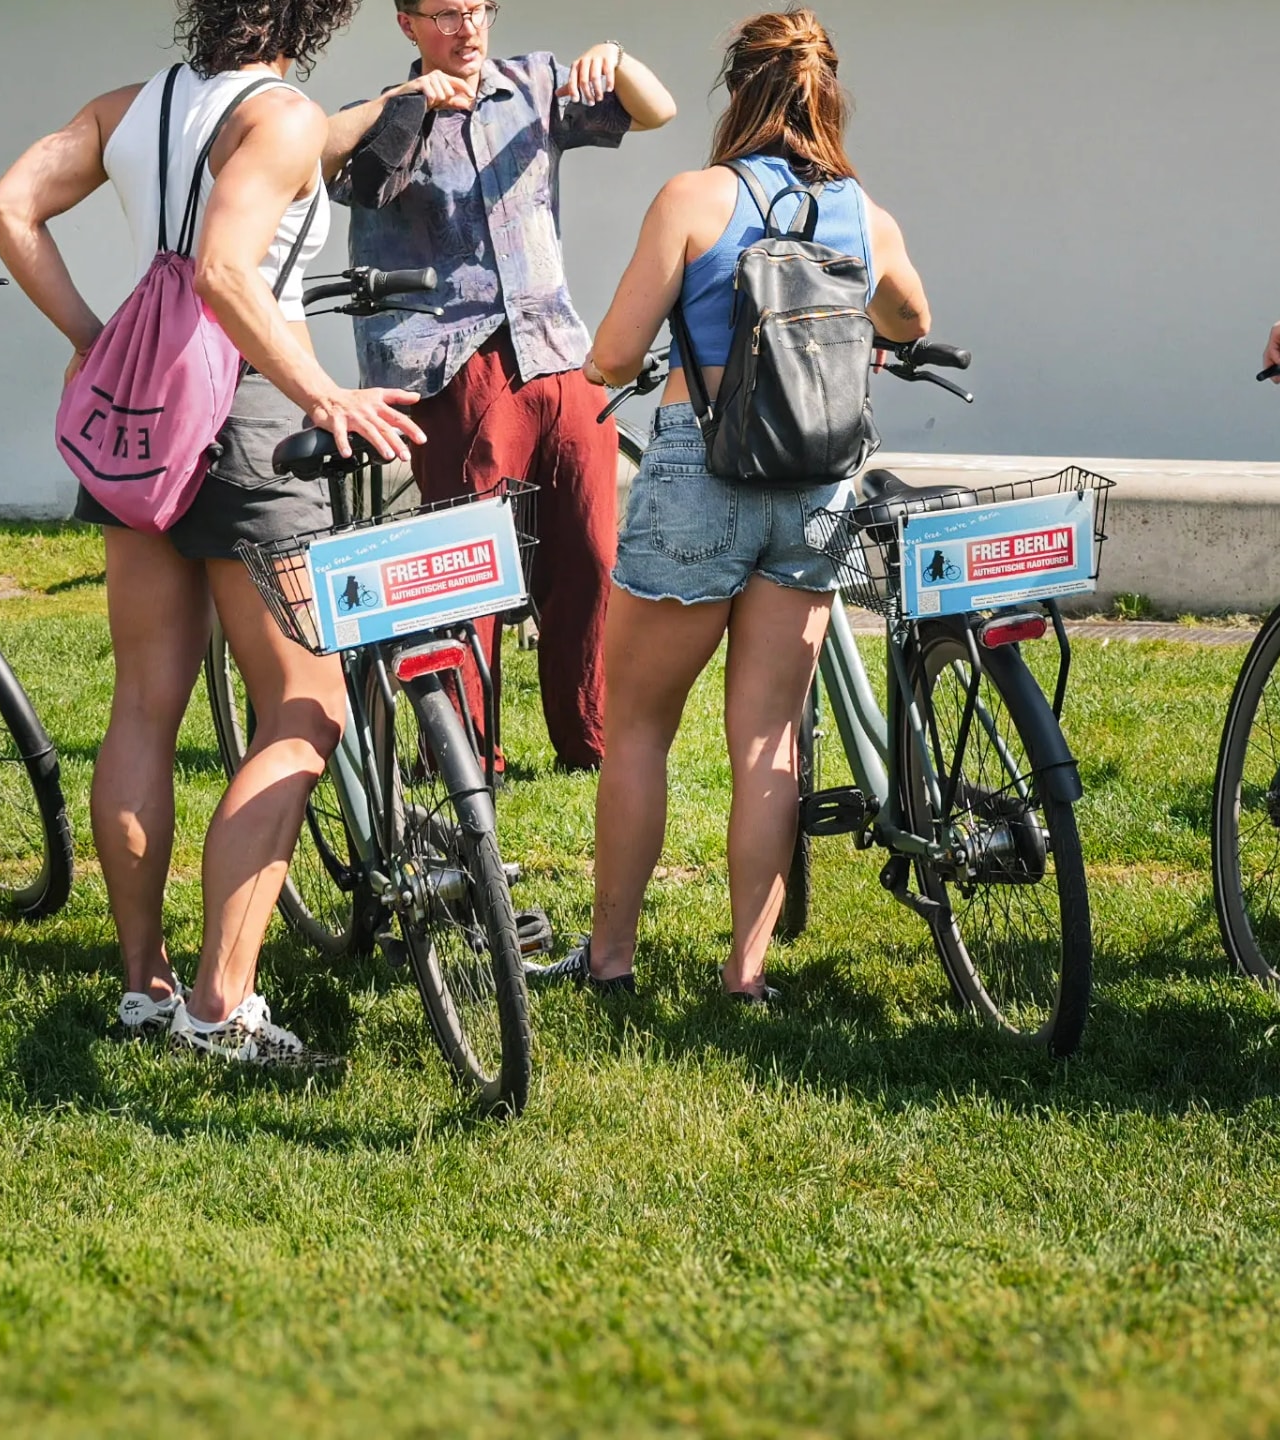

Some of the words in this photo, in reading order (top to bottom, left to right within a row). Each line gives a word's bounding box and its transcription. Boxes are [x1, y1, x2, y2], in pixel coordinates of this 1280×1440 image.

[971, 540, 1010, 562] FREE
[1014, 531, 1068, 556] BERLIN
[386, 558, 429, 585] FREE
[431, 544, 491, 575] BERLIN
[972, 562, 1025, 577] AUTHENTISCHE
[1026, 555, 1069, 569] RADTOUREN
[391, 581, 447, 601] AUTHENTISCHE
[448, 570, 493, 588] RADTOUREN
